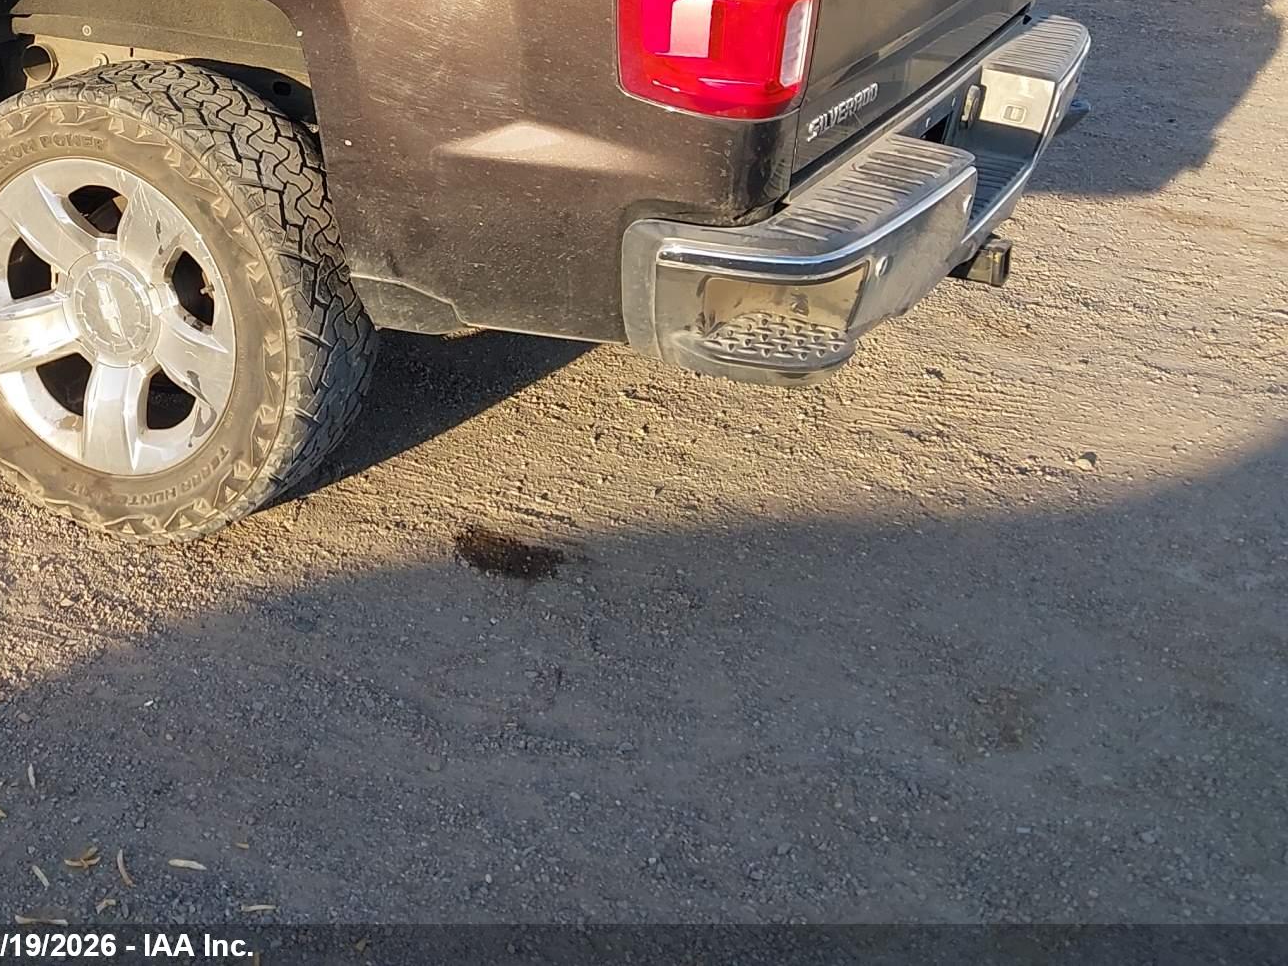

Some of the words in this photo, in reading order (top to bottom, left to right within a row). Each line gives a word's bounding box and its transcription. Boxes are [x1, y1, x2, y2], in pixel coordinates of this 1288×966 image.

[806, 82, 879, 142] SILVERADO
[39, 134, 108, 152] POWER
[180, 445, 231, 493] TERRA
[106, 486, 178, 508] HUNTE
